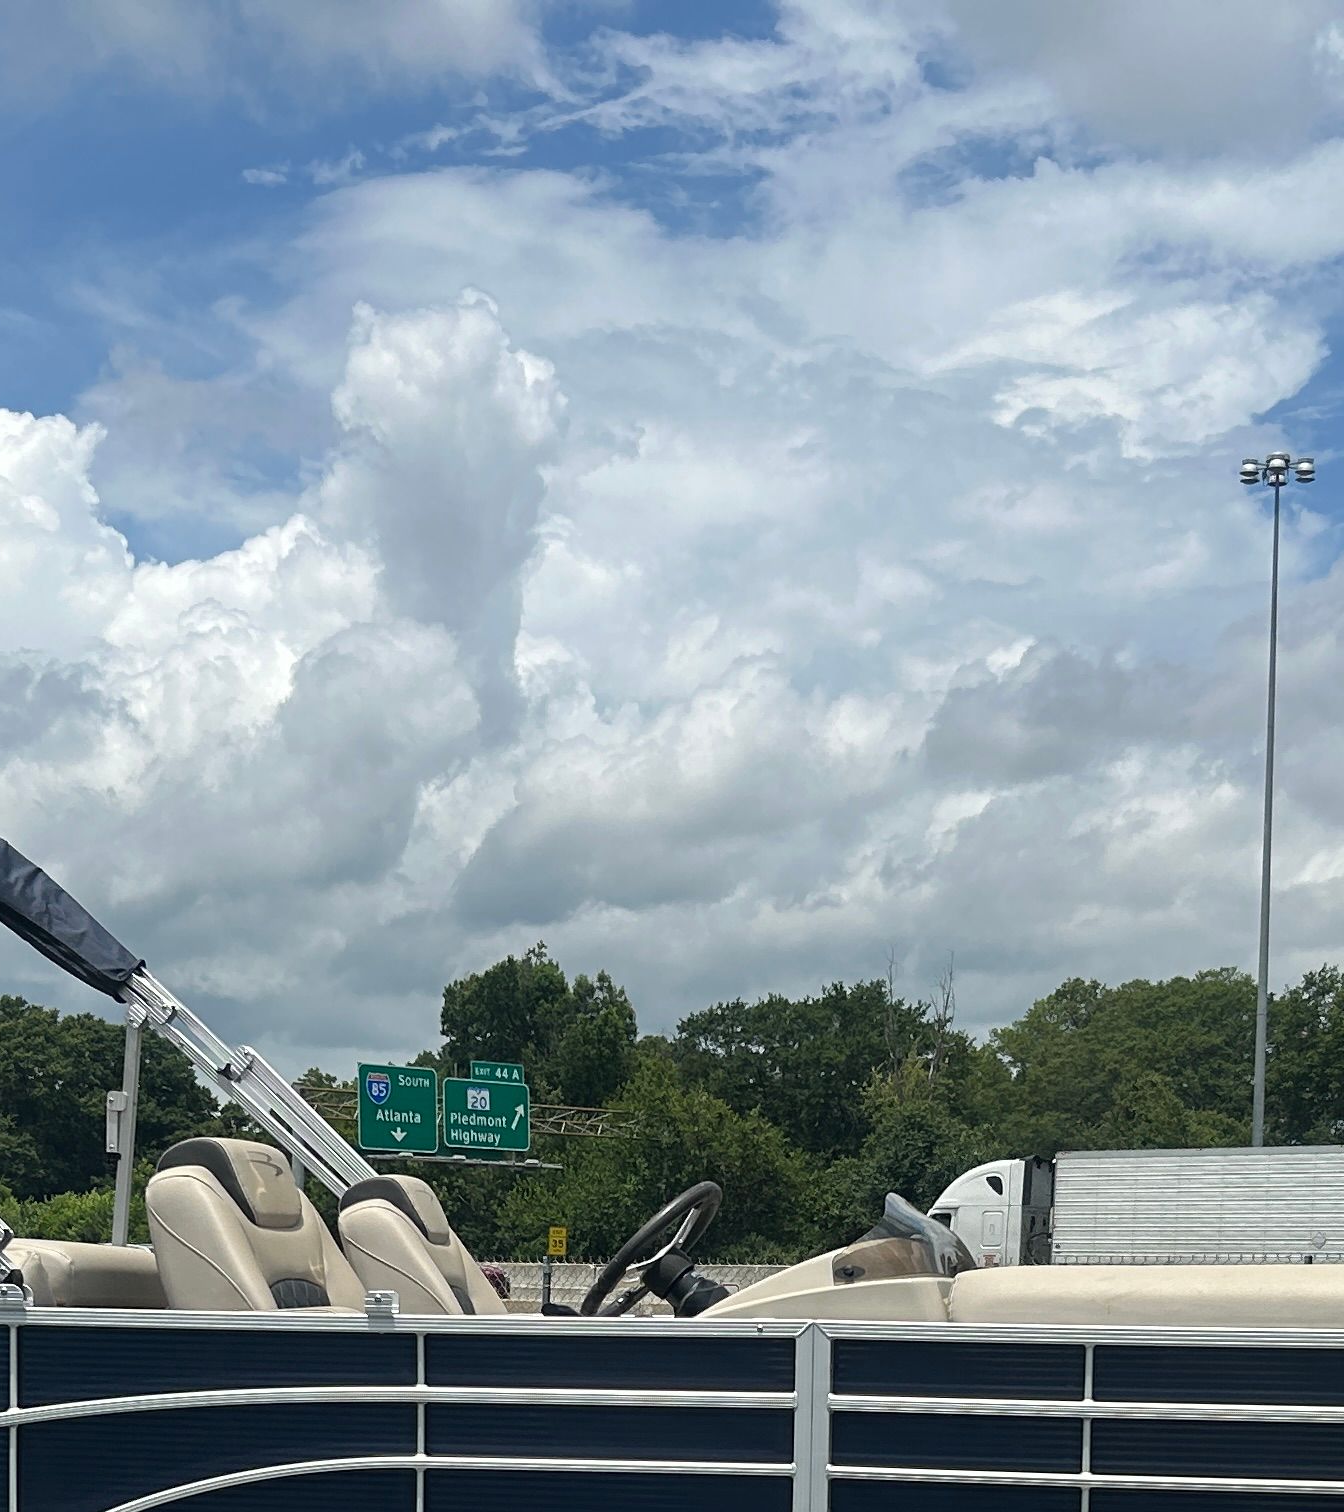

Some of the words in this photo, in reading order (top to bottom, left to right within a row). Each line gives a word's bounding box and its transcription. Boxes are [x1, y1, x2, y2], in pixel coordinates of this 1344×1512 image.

[474, 1066, 491, 1077] EXIT
[495, 1067, 509, 1079] 44
[512, 1068, 520, 1080] A
[398, 1074, 430, 1088] SOUTH
[371, 1082, 387, 1097] 85
[471, 1096, 487, 1109] 20
[376, 1108, 421, 1124] Atlanta
[450, 1112, 507, 1128] Piedmont
[450, 1128, 501, 1146] Highway
